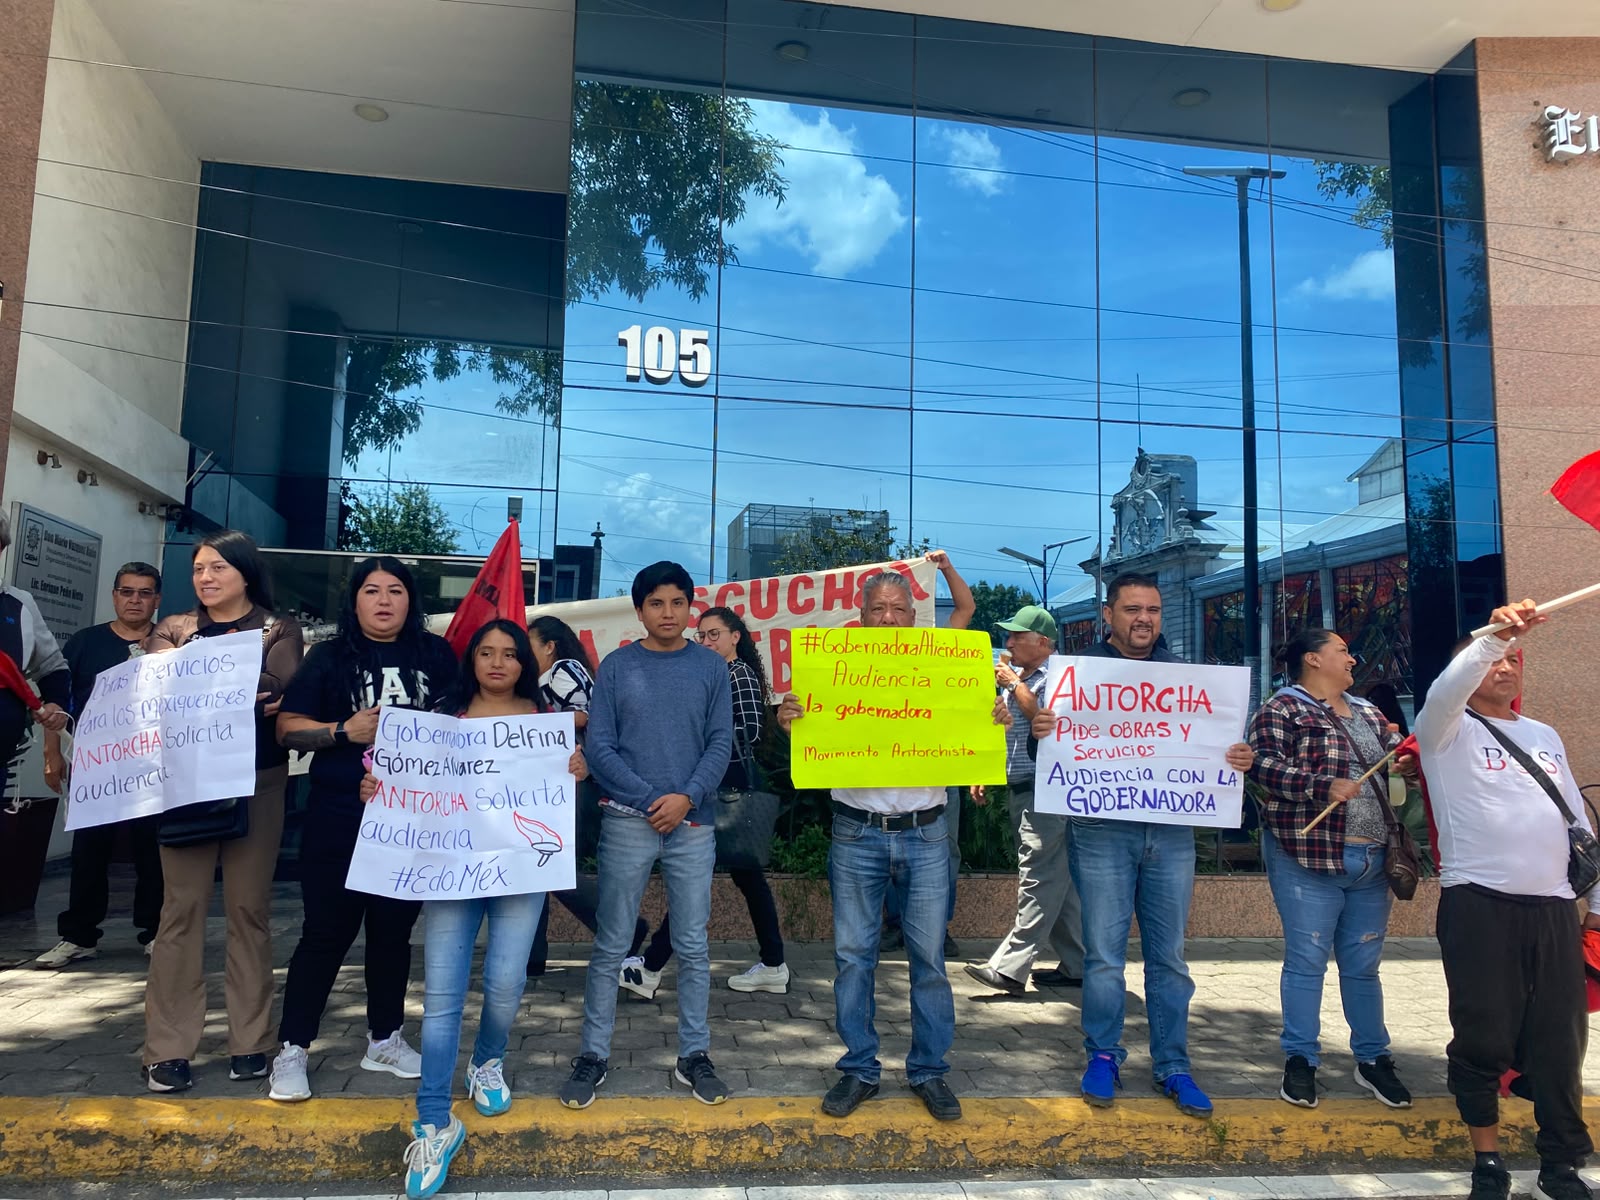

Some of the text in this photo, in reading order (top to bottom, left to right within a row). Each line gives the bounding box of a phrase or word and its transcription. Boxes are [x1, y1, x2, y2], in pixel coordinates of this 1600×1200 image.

[618, 325, 711, 388] 105
[145, 654, 235, 681] Servicios
[833, 660, 980, 688] Audiencia con
[1048, 665, 1213, 714] ANTORCHA
[113, 704, 135, 727] los
[806, 693, 932, 720] la gobernadora
[1109, 721, 1172, 738] OBRAS
[71, 730, 163, 773] ANTORCHA
[375, 748, 441, 777] Gómez
[804, 743, 976, 762] Movimiento Antorchista
[1167, 768, 1205, 783] CON
[1218, 769, 1237, 787] LA
[369, 780, 468, 817] ANTORCHA
[1066, 785, 1216, 815] GOBERNADORA
[360, 819, 473, 850] audiencia
